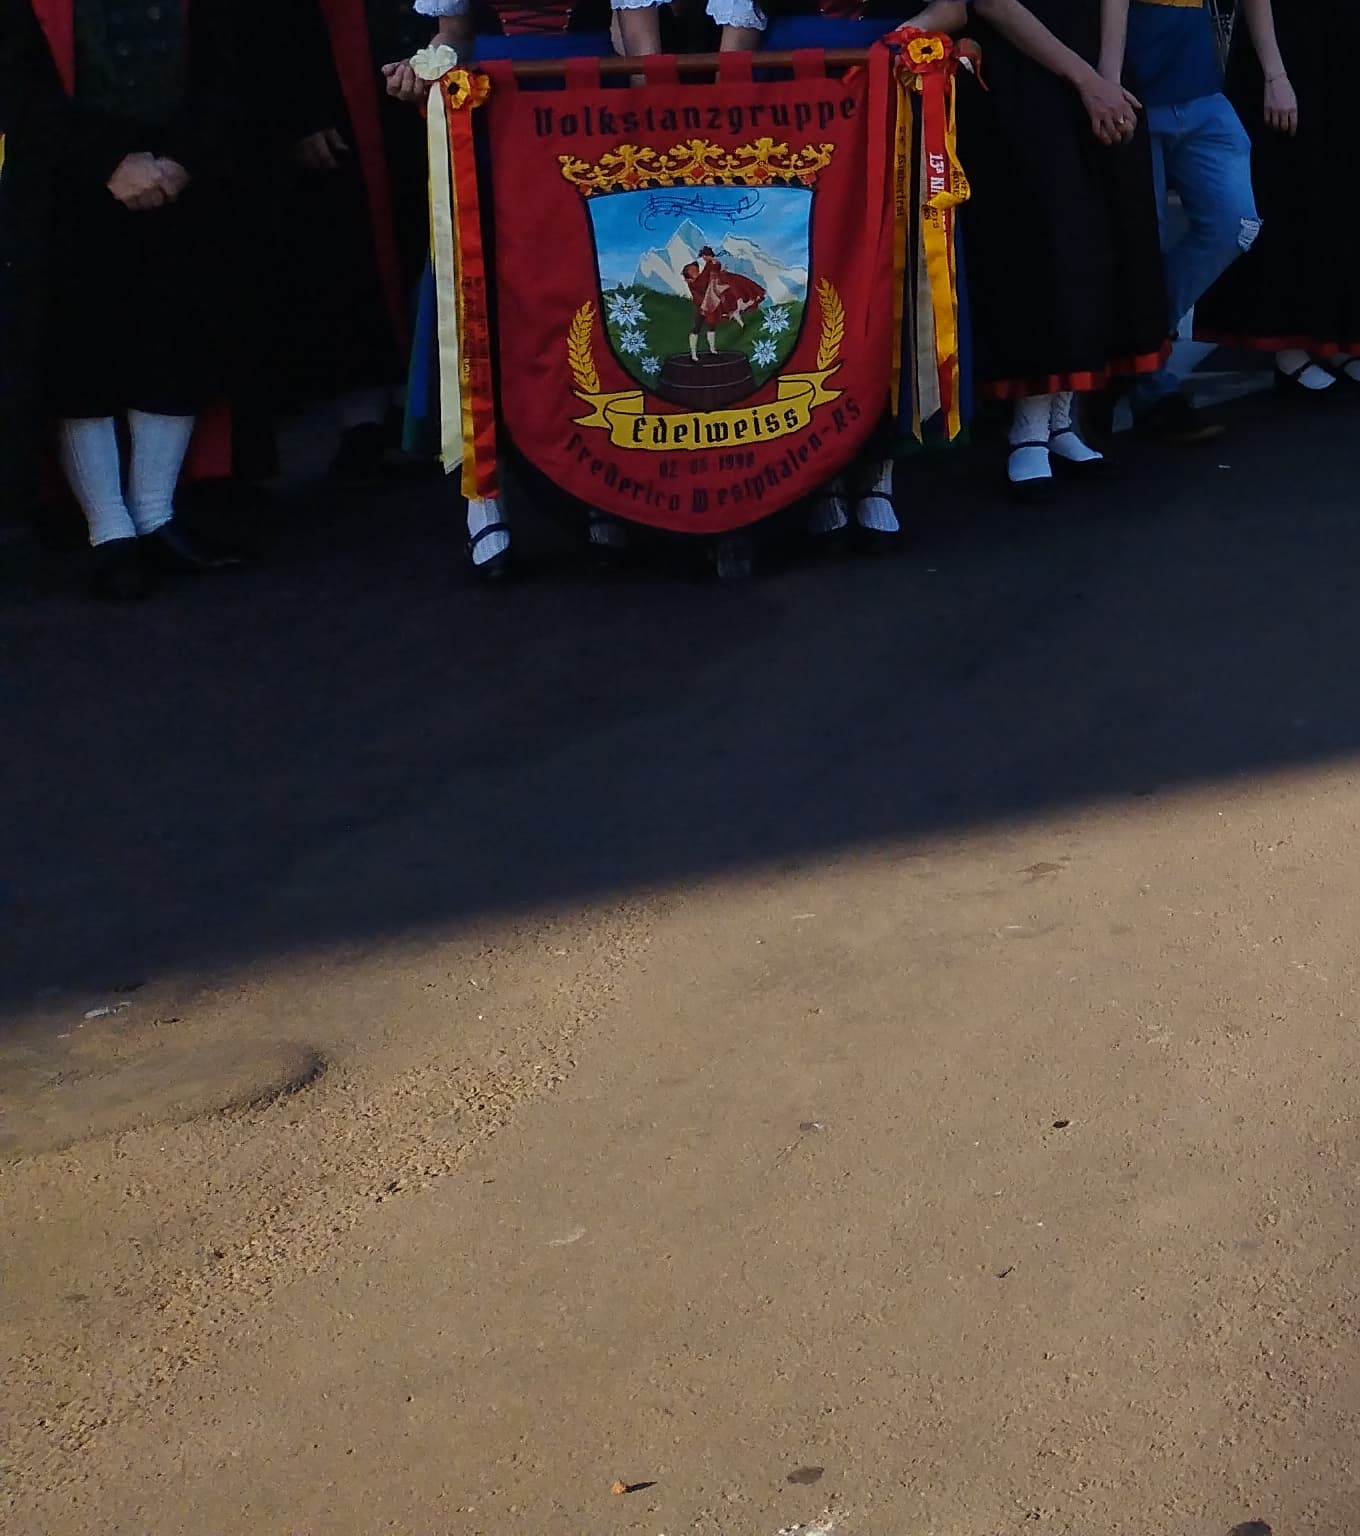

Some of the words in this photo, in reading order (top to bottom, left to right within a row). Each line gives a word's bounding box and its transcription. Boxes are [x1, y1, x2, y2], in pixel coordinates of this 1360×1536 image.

[532, 94, 858, 138] Volkstanzgruppe
[631, 405, 801, 445] Edelweiss
[564, 432, 682, 514] Frederico
